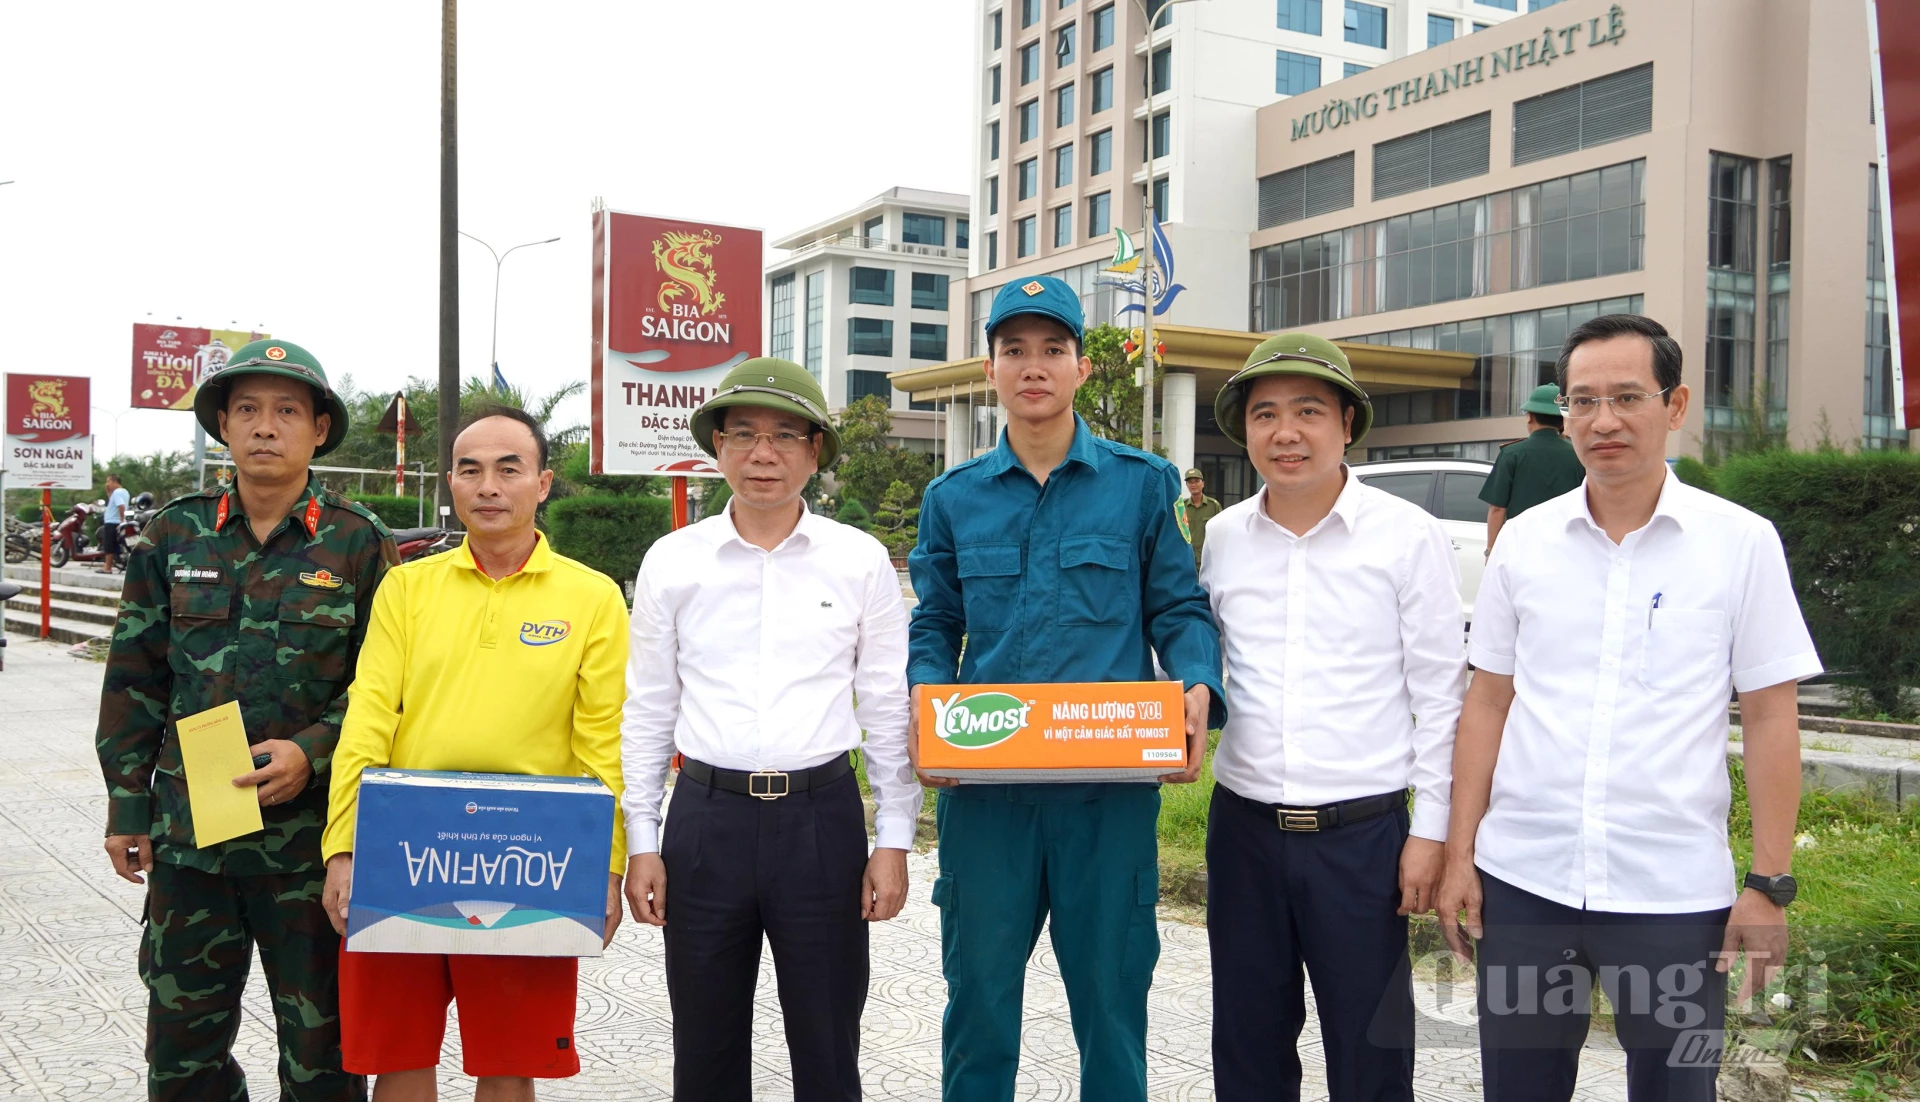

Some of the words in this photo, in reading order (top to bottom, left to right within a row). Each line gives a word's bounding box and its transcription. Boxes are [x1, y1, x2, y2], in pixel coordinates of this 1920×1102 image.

[1291, 92, 1378, 141] MƯỜNG
[1383, 56, 1484, 112] THANH
[1490, 26, 1581, 78] NHẬT
[1588, 4, 1626, 47] LỆ
[672, 304, 700, 318] BIA
[641, 315, 730, 344] SAIGON
[142, 354, 193, 372] TƯƠI
[203, 365, 226, 376] CAM
[156, 372, 186, 390] ĐÃ
[622, 382, 705, 409] THANH
[22, 418, 73, 430] SAIGON
[641, 413, 670, 433] ĐẶC
[672, 414, 691, 430] SẢ
[657, 434, 669, 443] Điện
[670, 435, 685, 443] thoại:
[619, 441, 628, 449] Địa
[639, 442, 657, 450] Đường
[658, 443, 677, 451] Trương
[14, 447, 42, 459] SƠN
[46, 446, 83, 460] NGÂN
[23, 461, 39, 470] ĐẶC
[40, 461, 55, 469] SẢN
[57, 461, 74, 470] BIỂN
[191, 569, 201, 578] VĂN
[520, 622, 565, 637] DVTH
[1052, 701, 1088, 720] NĂNG
[1091, 700, 1135, 722] LƯỢNG
[1137, 701, 1163, 720] YO!
[1043, 726, 1053, 739] VÌ
[1055, 726, 1073, 741] MỘT
[1074, 725, 1092, 739] CẢM
[1095, 725, 1115, 738] GIÁC
[1116, 724, 1133, 738] RẤT
[1135, 727, 1169, 738] YOMOST
[437, 831, 459, 841] khiết
[461, 832, 478, 840] tinh
[479, 832, 490, 841] sự
[492, 833, 508, 843] của
[510, 833, 532, 842] ngon
[534, 834, 542, 843] vị
[403, 841, 573, 890] AQUAFINA
